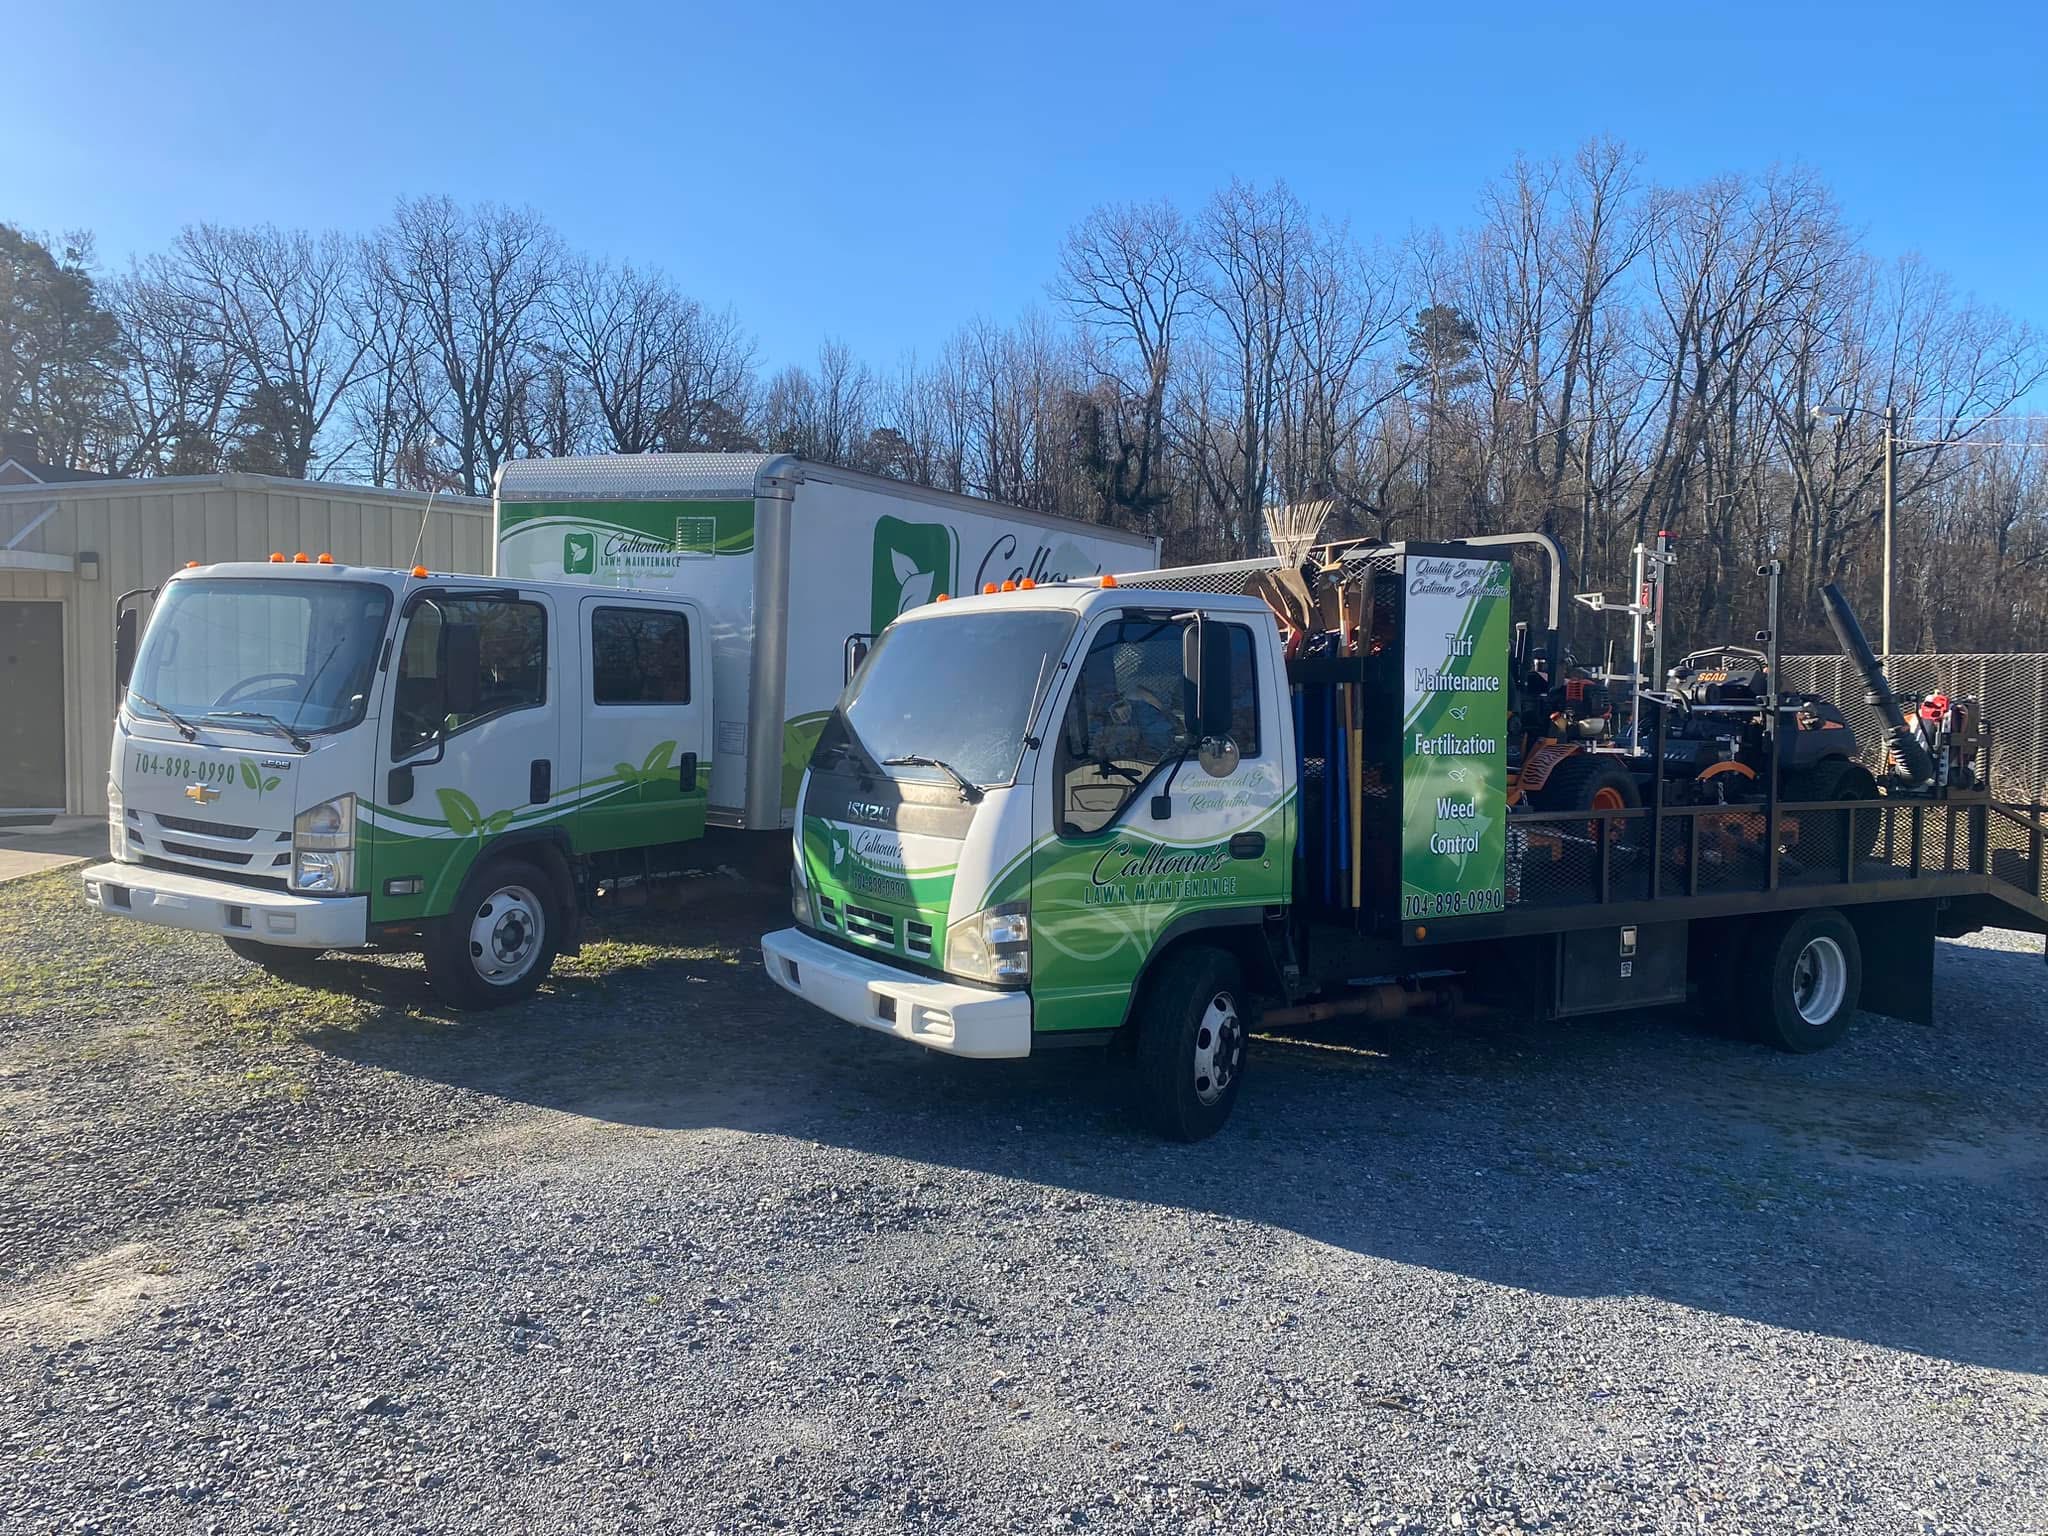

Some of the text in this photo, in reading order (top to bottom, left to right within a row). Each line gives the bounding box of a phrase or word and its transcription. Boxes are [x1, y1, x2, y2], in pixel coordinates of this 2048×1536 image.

[604, 532, 677, 556] Calhoun's
[600, 556, 681, 568] LAWN MAINTENANCE
[1416, 559, 1455, 581] Quality
[1453, 561, 1489, 579] Service
[1409, 577, 1509, 598] Customer Satisfaction
[1444, 633, 1473, 656] Turf
[1414, 668, 1500, 692] Maintenance
[1415, 733, 1496, 755] Fertilization
[135, 752, 235, 785] 704-898-0990
[847, 801, 890, 823] ISUZU
[1436, 796, 1476, 819] Weed
[855, 830, 905, 858] Calhoun's
[1430, 831, 1480, 855] Control
[1091, 840, 1231, 886] Calhoun's
[1084, 877, 1237, 904] LAWN MAINTENANCE
[1404, 887, 1501, 917] 704-898-0990
